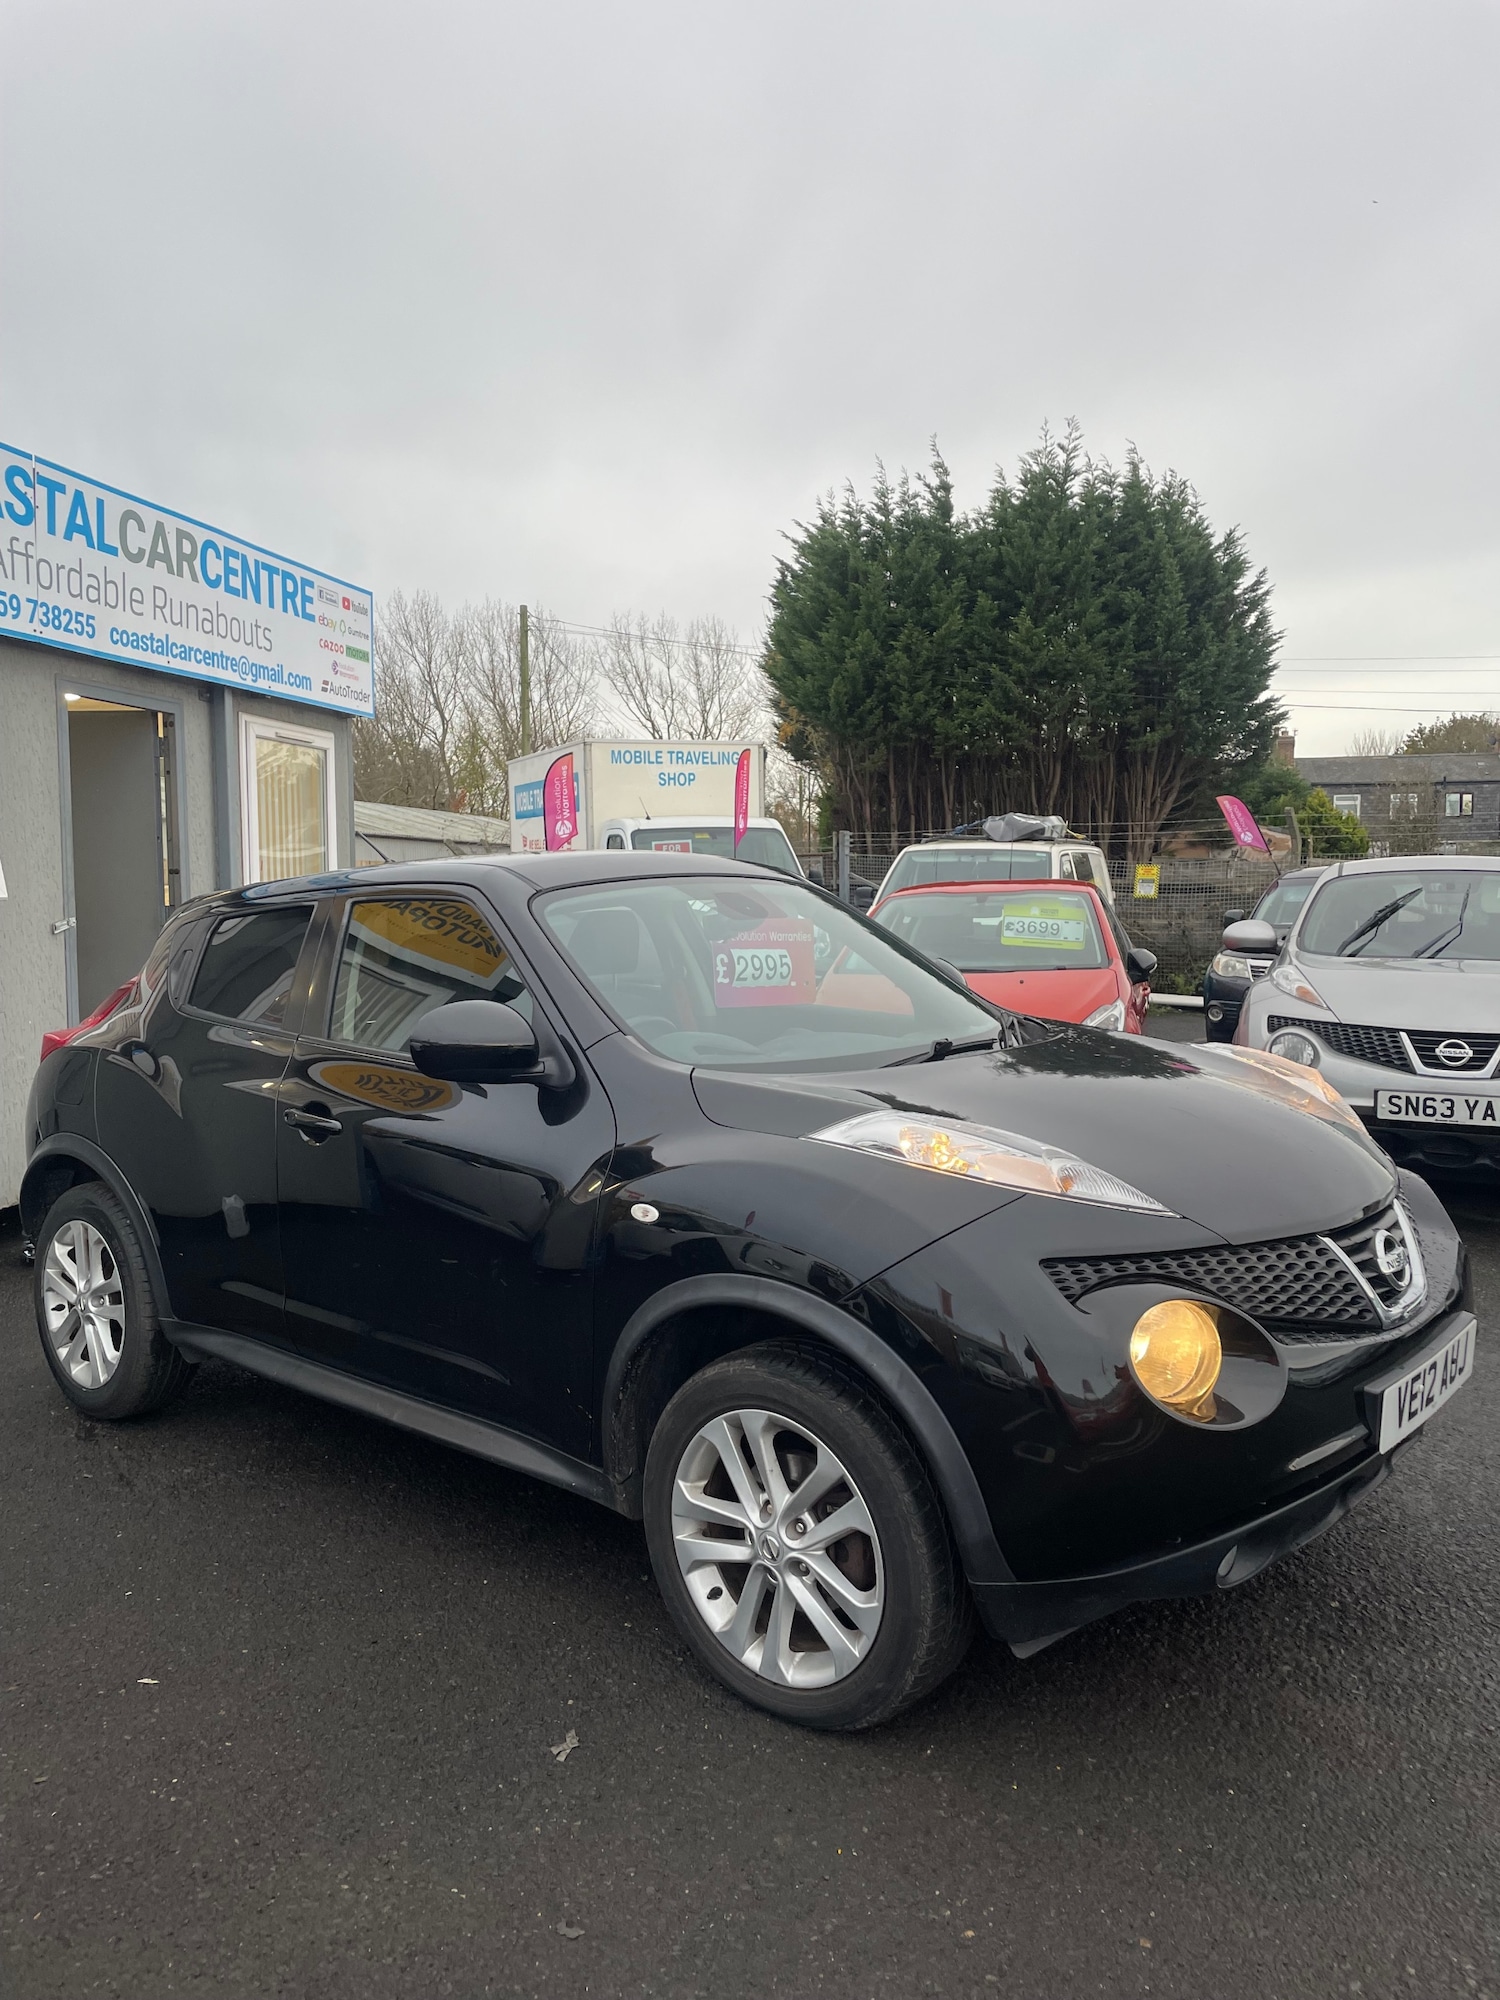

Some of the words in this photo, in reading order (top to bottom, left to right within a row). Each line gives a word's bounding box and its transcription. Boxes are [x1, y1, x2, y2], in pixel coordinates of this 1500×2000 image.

[0, 465, 316, 622] STALCARCENTRE
[351, 599, 368, 617] YouTube
[153, 585, 272, 652] Runabouts
[318, 612, 337, 632] ebay
[348, 626, 369, 640] Gumtree
[26, 597, 96, 639] 738255
[110, 627, 312, 691] coastalcarcentre@gmail.com
[329, 681, 370, 703] AutoTrader
[611, 750, 663, 764] MOBILE
[667, 751, 740, 765] TRAVELING
[658, 772, 696, 786] SHOP
[561, 765, 570, 819] Warranties
[662, 844, 681, 852] FOR
[769, 931, 811, 941] Warranties
[1004, 920, 1060, 936] £3699
[1388, 1094, 1455, 1118] SN63
[1464, 1099, 1496, 1121] YA
[1398, 1361, 1437, 1429] VE12
